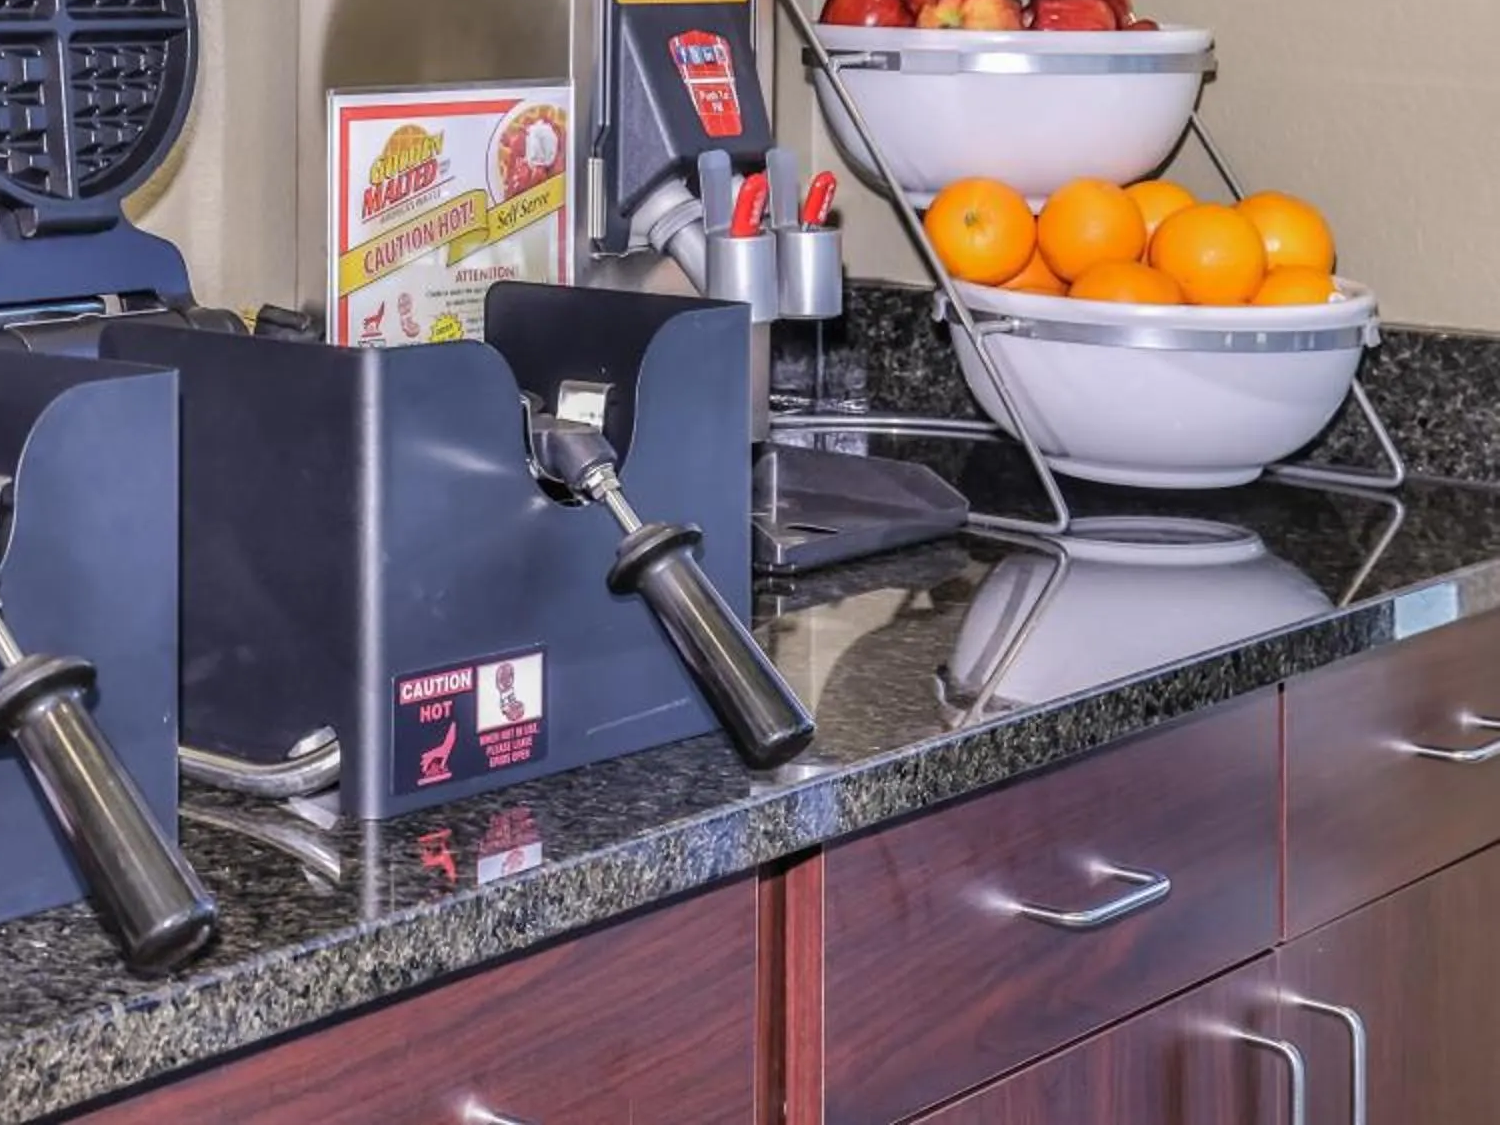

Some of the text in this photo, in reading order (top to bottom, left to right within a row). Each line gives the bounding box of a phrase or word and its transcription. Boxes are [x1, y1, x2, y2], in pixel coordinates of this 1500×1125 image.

[362, 159, 438, 218] MALTED
[497, 204, 521, 229] Self
[363, 199, 476, 274] CAUTION HOT!
[402, 671, 472, 700] CAUTION
[419, 700, 453, 723] HOT
